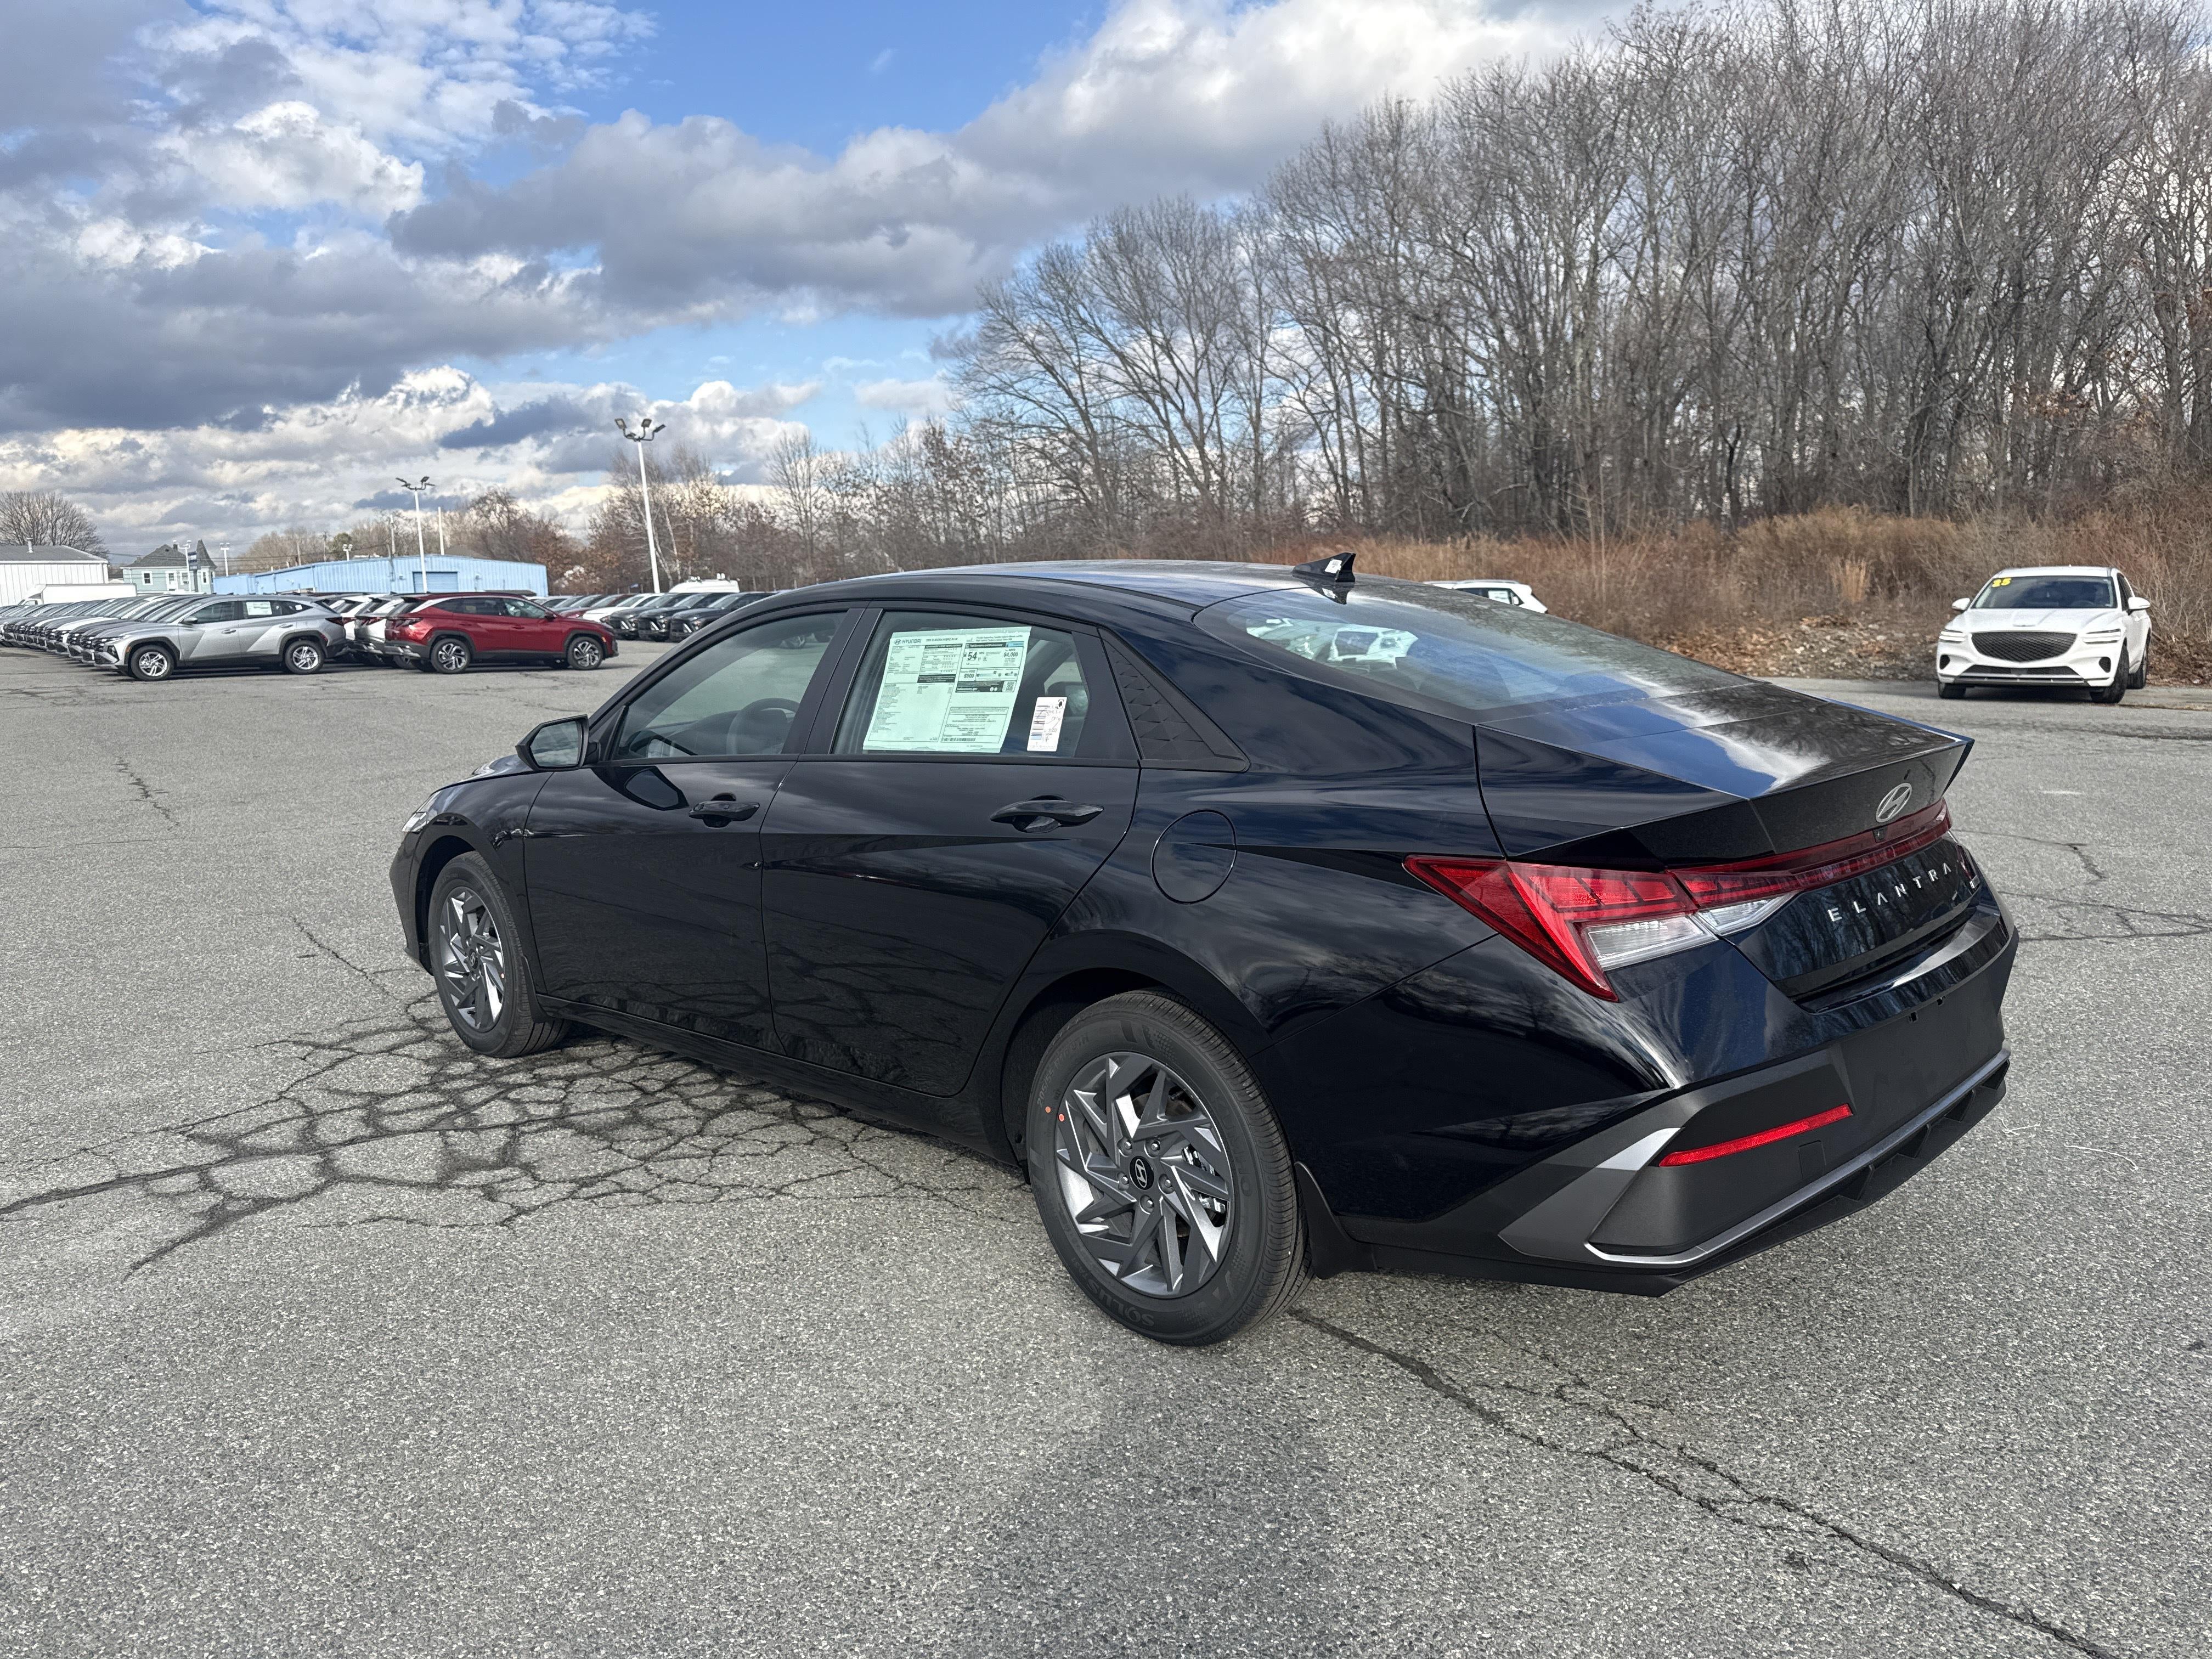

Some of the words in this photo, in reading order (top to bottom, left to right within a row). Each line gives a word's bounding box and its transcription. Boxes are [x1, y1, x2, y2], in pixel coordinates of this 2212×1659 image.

[967, 652, 977, 661] 54
[1827, 862, 1952, 922] ELANTRA
[1085, 1276, 1154, 1327] SOLUS
